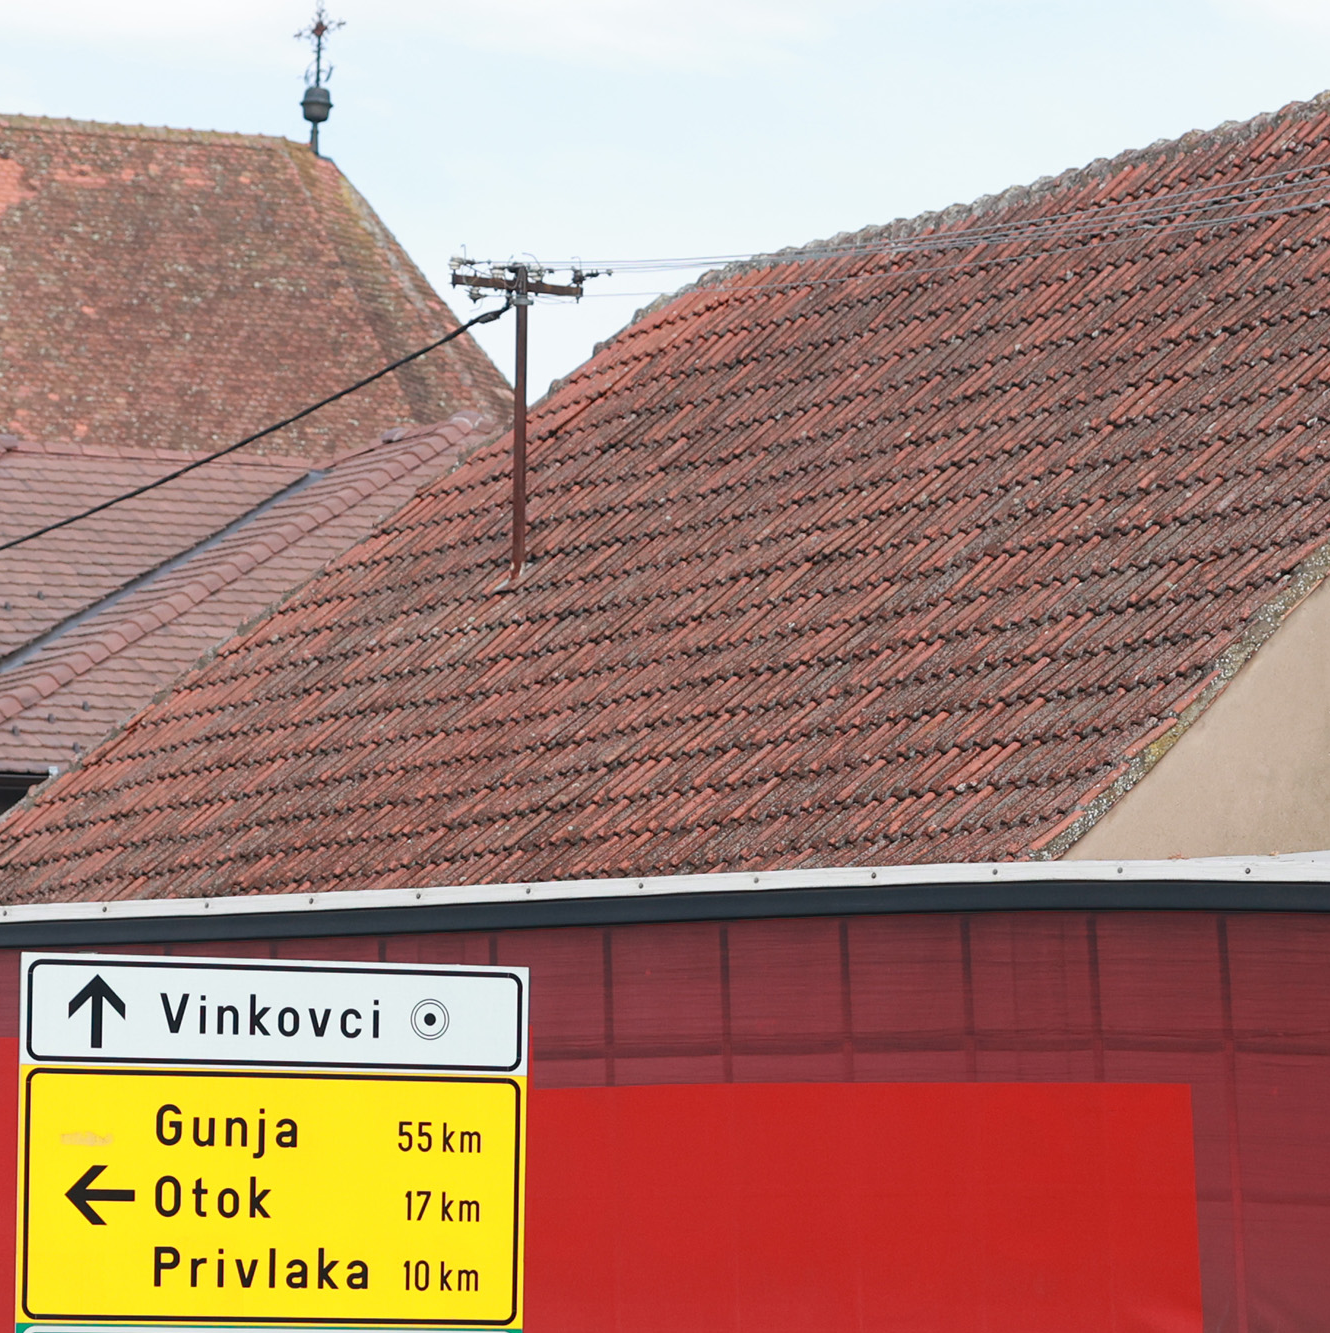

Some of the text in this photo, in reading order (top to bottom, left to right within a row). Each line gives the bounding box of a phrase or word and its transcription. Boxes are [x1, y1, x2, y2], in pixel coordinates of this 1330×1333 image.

[160, 992, 380, 1039] Vinkovci
[155, 1103, 481, 1159] Gunja 55 km
[155, 1175, 480, 1223] Otok 17 km
[153, 1246, 479, 1292] Privlaka 10 km
